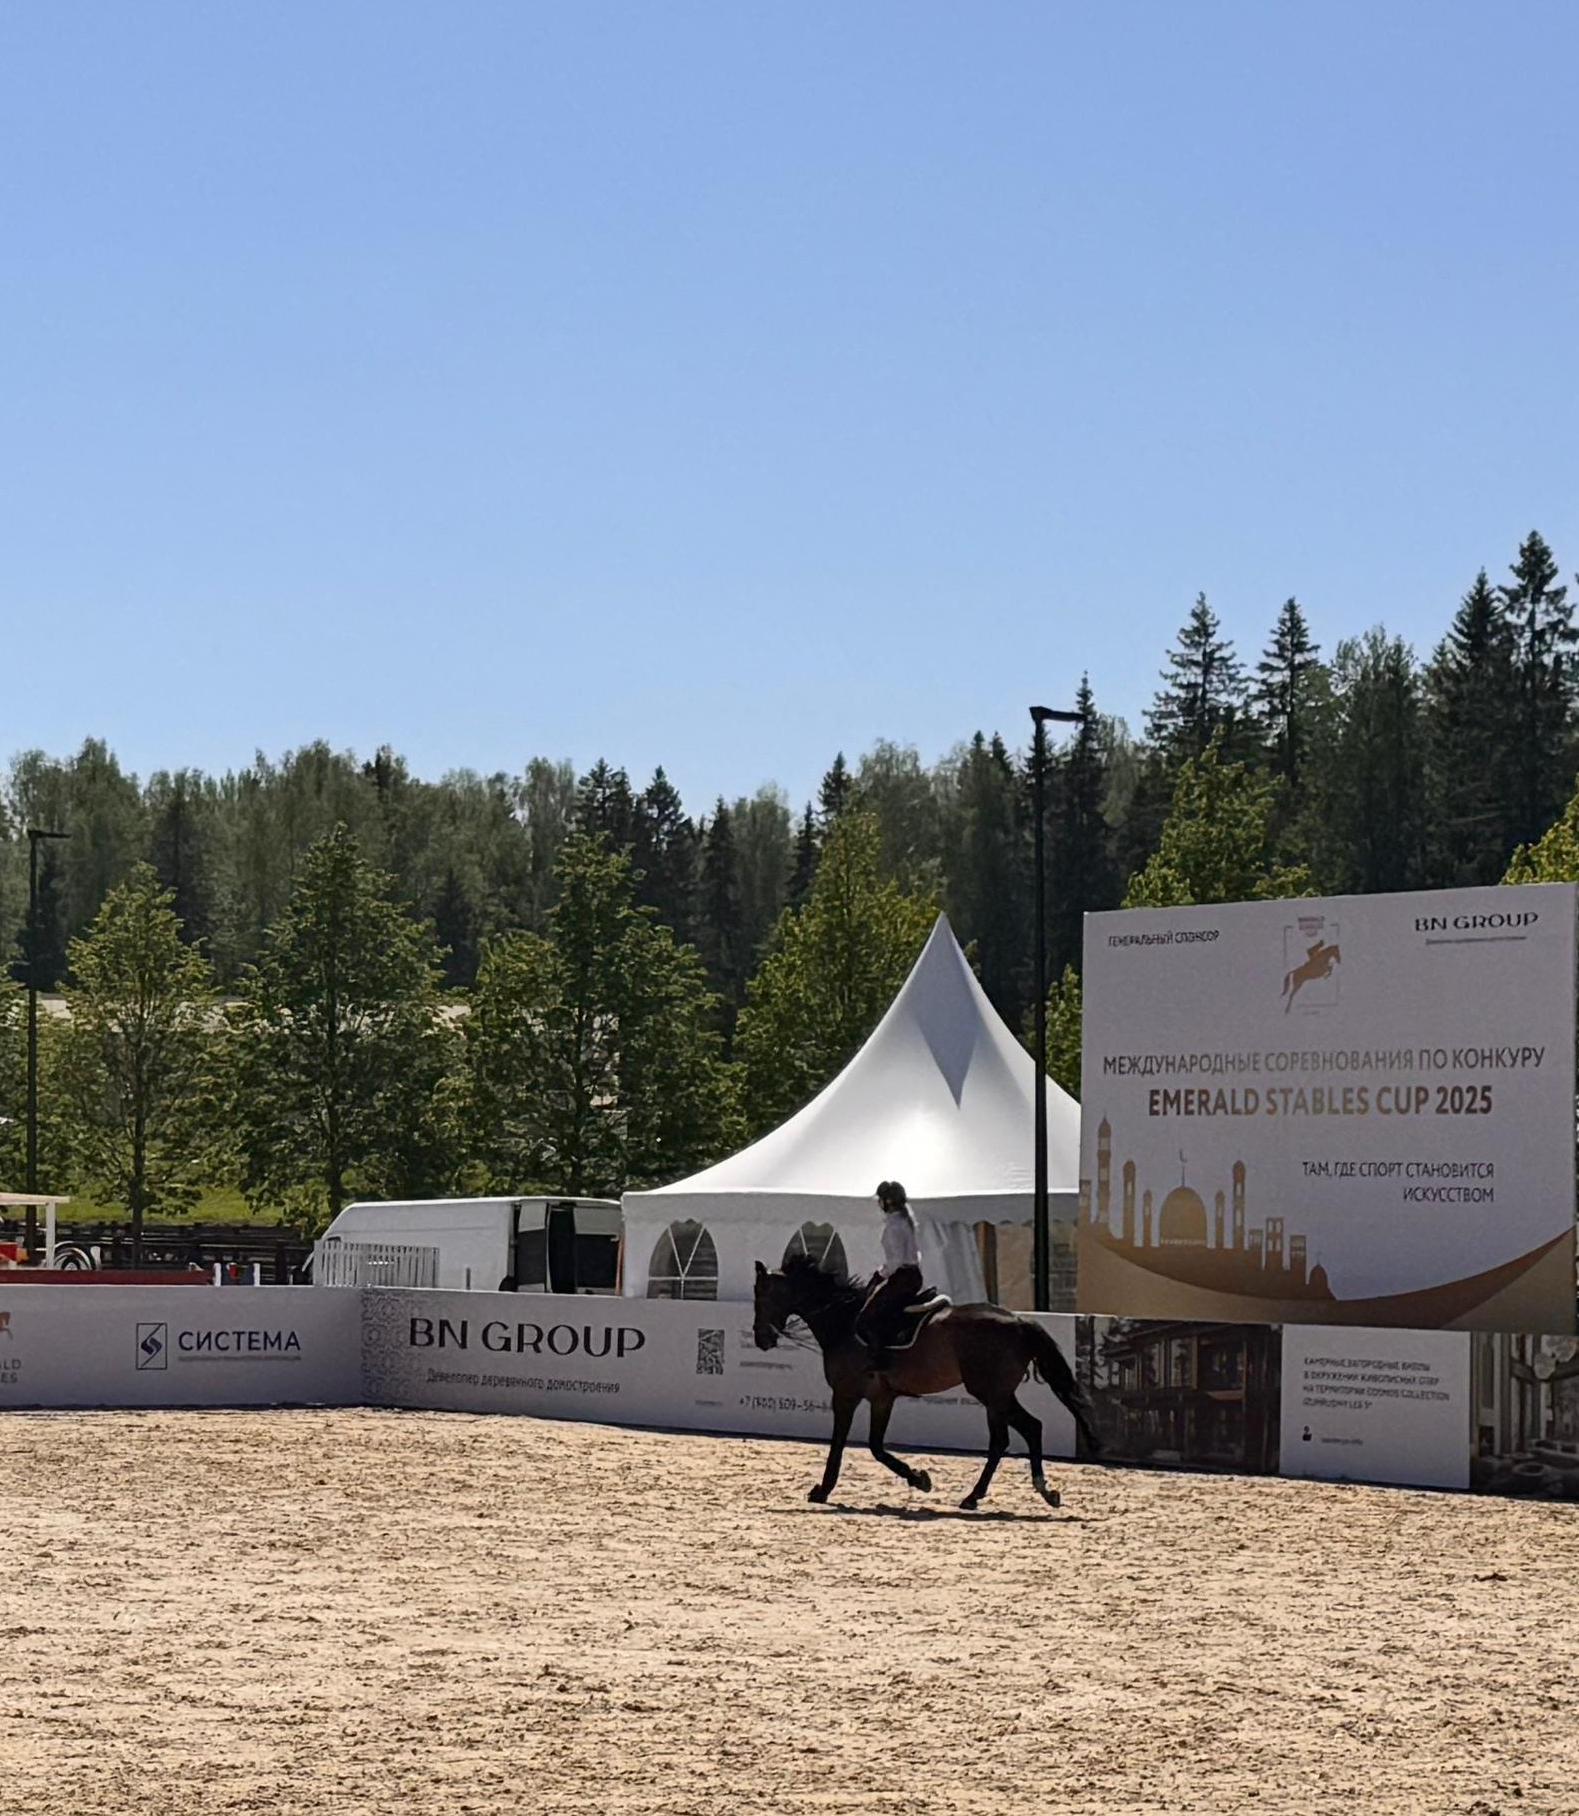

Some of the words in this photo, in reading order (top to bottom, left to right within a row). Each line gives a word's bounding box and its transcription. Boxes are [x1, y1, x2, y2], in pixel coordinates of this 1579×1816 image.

[1415, 917, 1447, 932] BN
[1453, 912, 1539, 929] GROUP
[1103, 1052, 1260, 1078] МЕЖДУНАРОДНЫЕ
[1264, 1049, 1414, 1074] СОРЕВНОВАНИЯ
[1419, 1049, 1448, 1071] ПО
[1453, 1046, 1546, 1069] КОНКУРУ
[1148, 1087, 1260, 1117] EMERALD
[1265, 1086, 1370, 1116] STABLES
[1376, 1085, 1430, 1115] CUP
[1435, 1085, 1493, 1115] 2025
[1334, 1162, 1356, 1178] ГДЕ
[1359, 1162, 1403, 1178] СПОРТ
[1405, 1162, 1495, 1179] СТАНОВИТСЯ
[1403, 1186, 1495, 1203] ИСКУССТВОМ
[178, 1331, 302, 1351] СИСТЕМА
[409, 1317, 468, 1349] BN
[482, 1320, 646, 1358] GROUP
